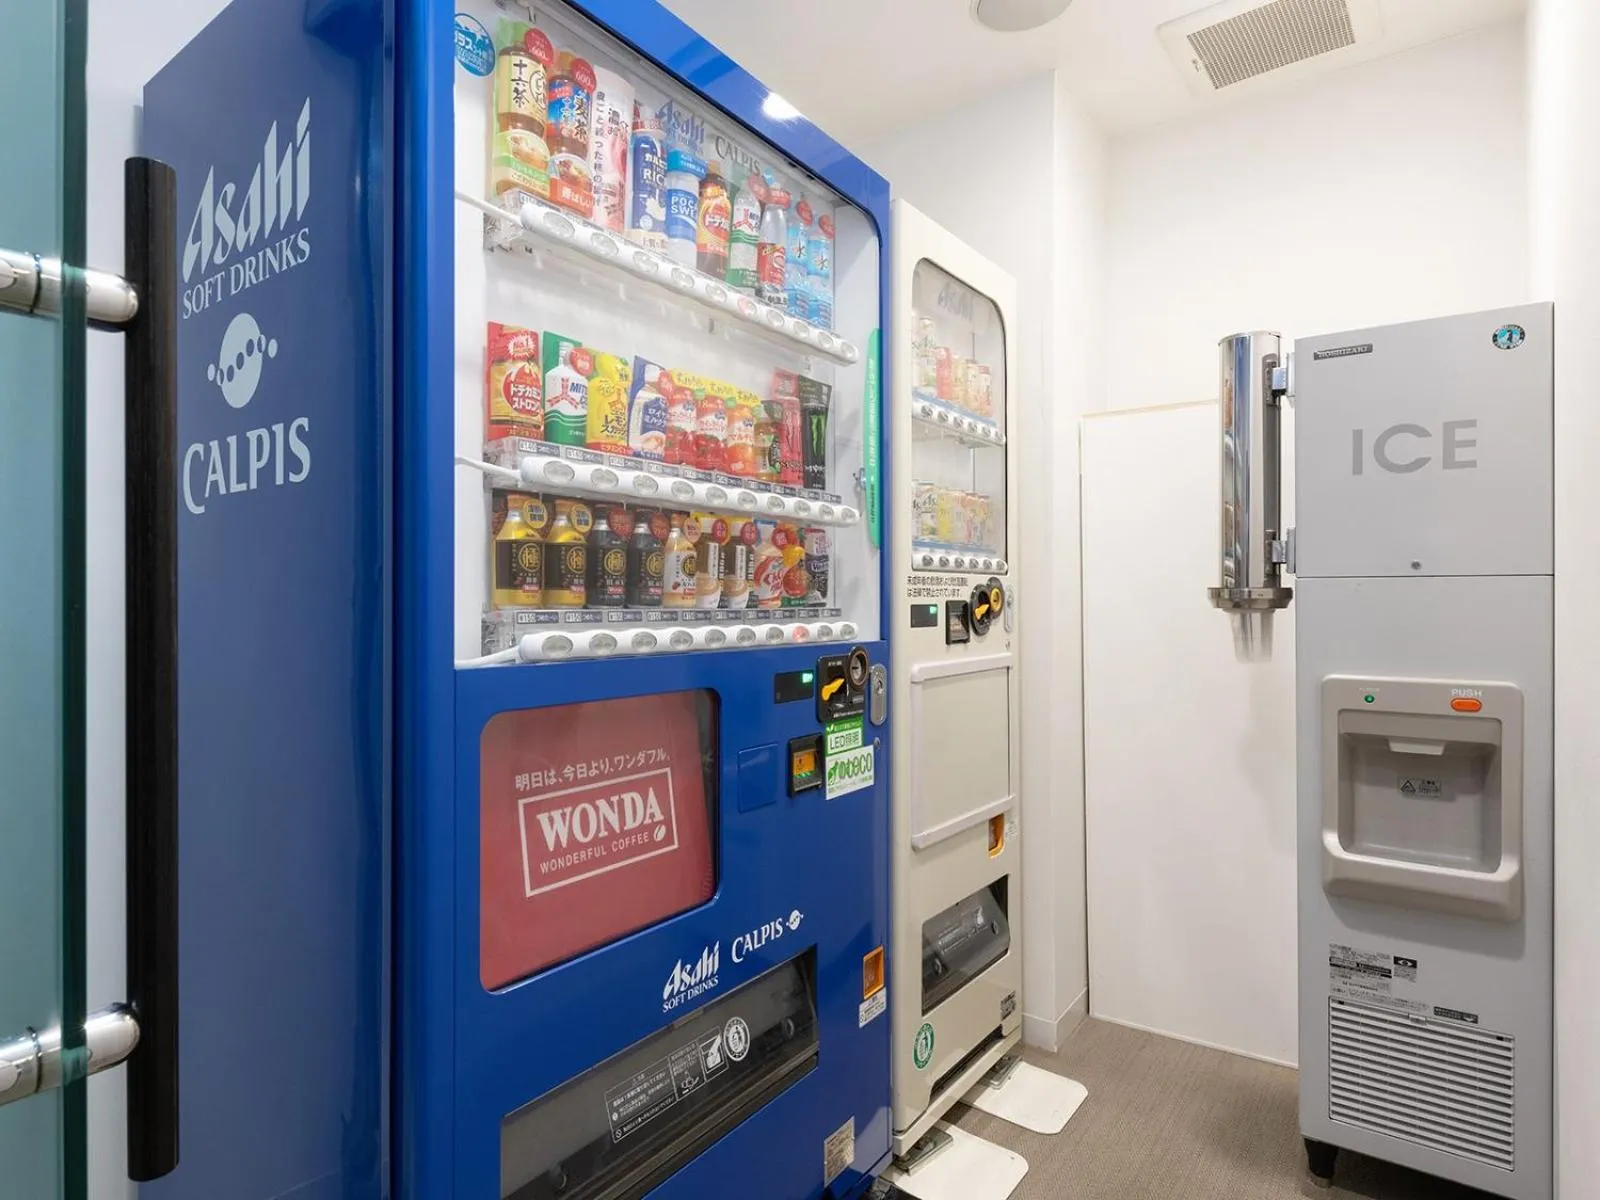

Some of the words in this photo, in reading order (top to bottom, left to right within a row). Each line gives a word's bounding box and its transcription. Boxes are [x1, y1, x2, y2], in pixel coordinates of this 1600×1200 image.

[643, 167, 667, 187] RIC
[715, 134, 761, 176] CALPIS
[182, 96, 310, 283] Asahi
[182, 271, 226, 320] SOFT
[229, 227, 311, 296] DRINKS
[183, 417, 311, 515] CALPIS
[1352, 419, 1478, 476] ICE
[1451, 688, 1483, 697] PUSH
[515, 748, 671, 792] 明日は、今日より、ワンダフル。
[536, 787, 665, 852] WONDA
[540, 847, 607, 875] WONDERFUL
[611, 831, 650, 852] COFFEE
[731, 917, 784, 963] CALPIS
[662, 940, 720, 1000] Asahi
[662, 992, 687, 1013] SOFT
[687, 974, 720, 1001] DRINKS
